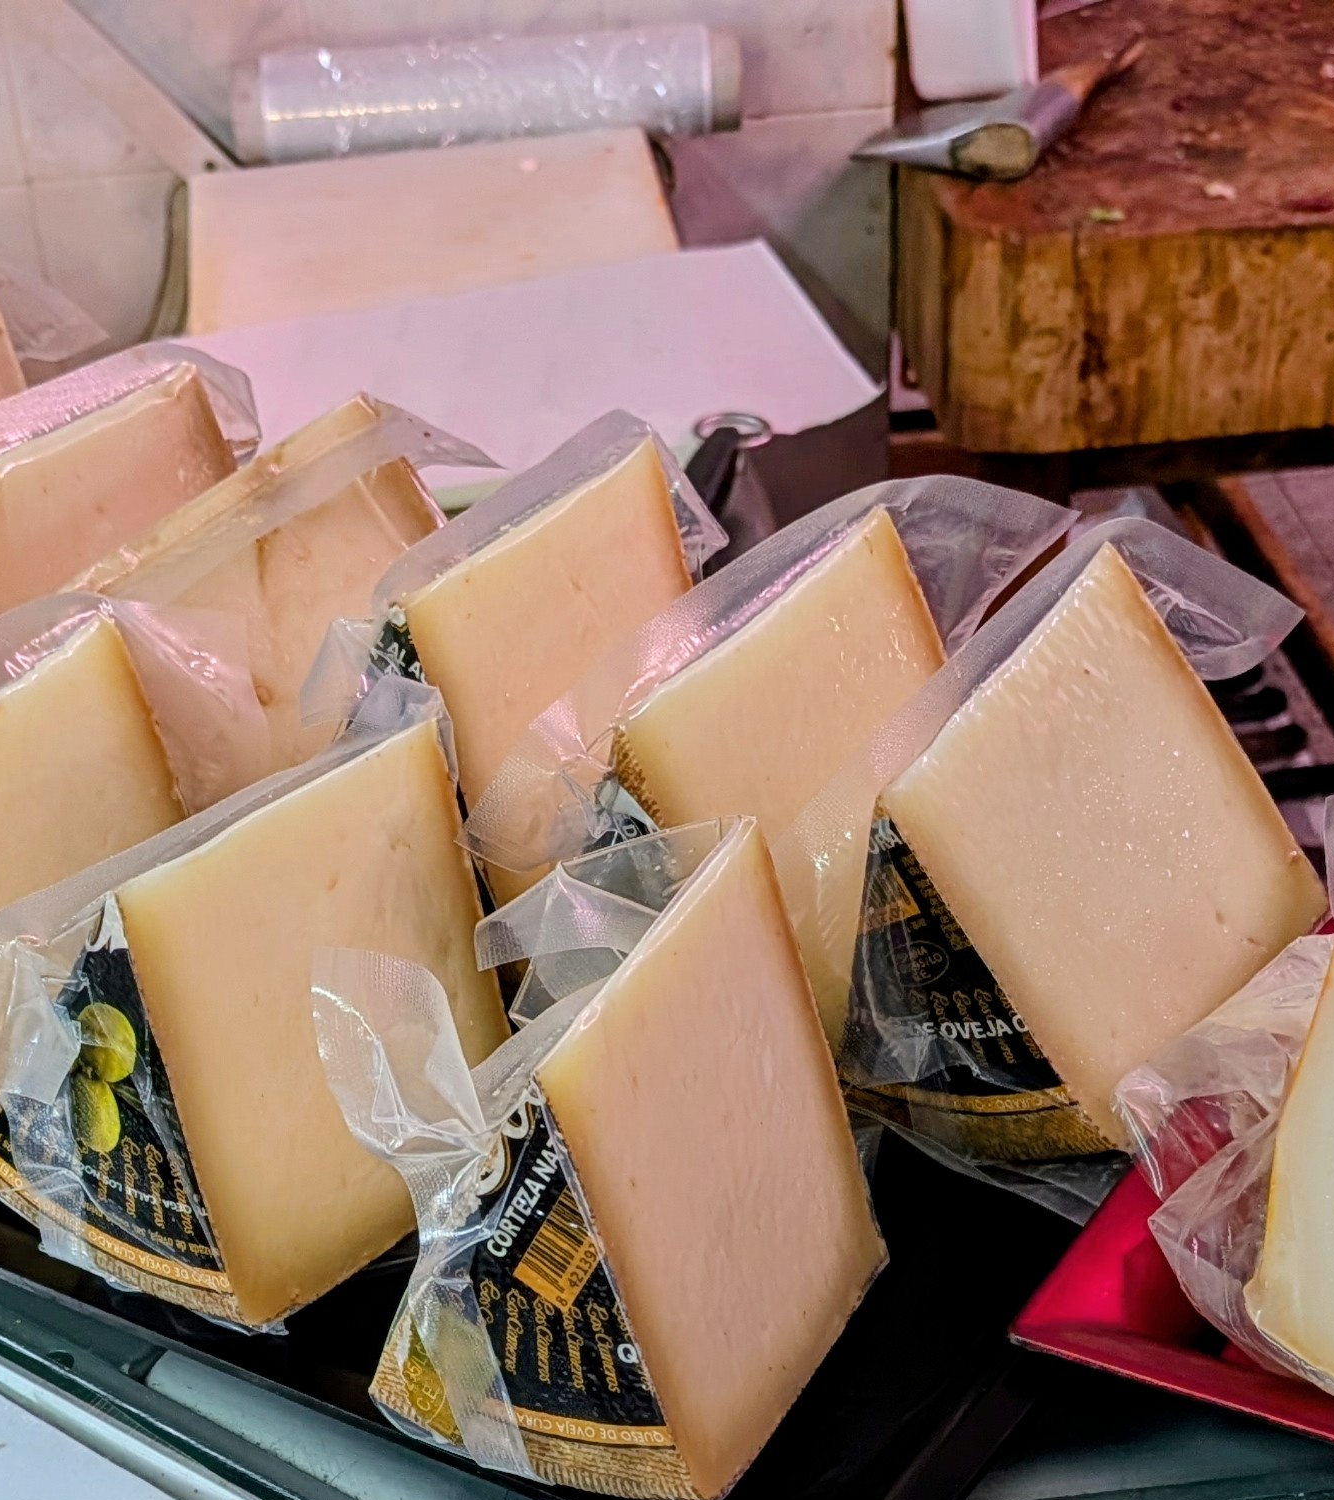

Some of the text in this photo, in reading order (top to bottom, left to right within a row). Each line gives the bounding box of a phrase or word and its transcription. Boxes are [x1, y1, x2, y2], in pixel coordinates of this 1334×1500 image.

[940, 1019, 1013, 1040] OVEJA
[487, 1176, 546, 1259] CORTEZA
[88, 1230, 136, 1264] CURADO
[138, 1253, 171, 1275] OVEJA
[174, 1267, 190, 1280] DE
[516, 1412, 665, 1443] QUESO DE OVEJA CURA
